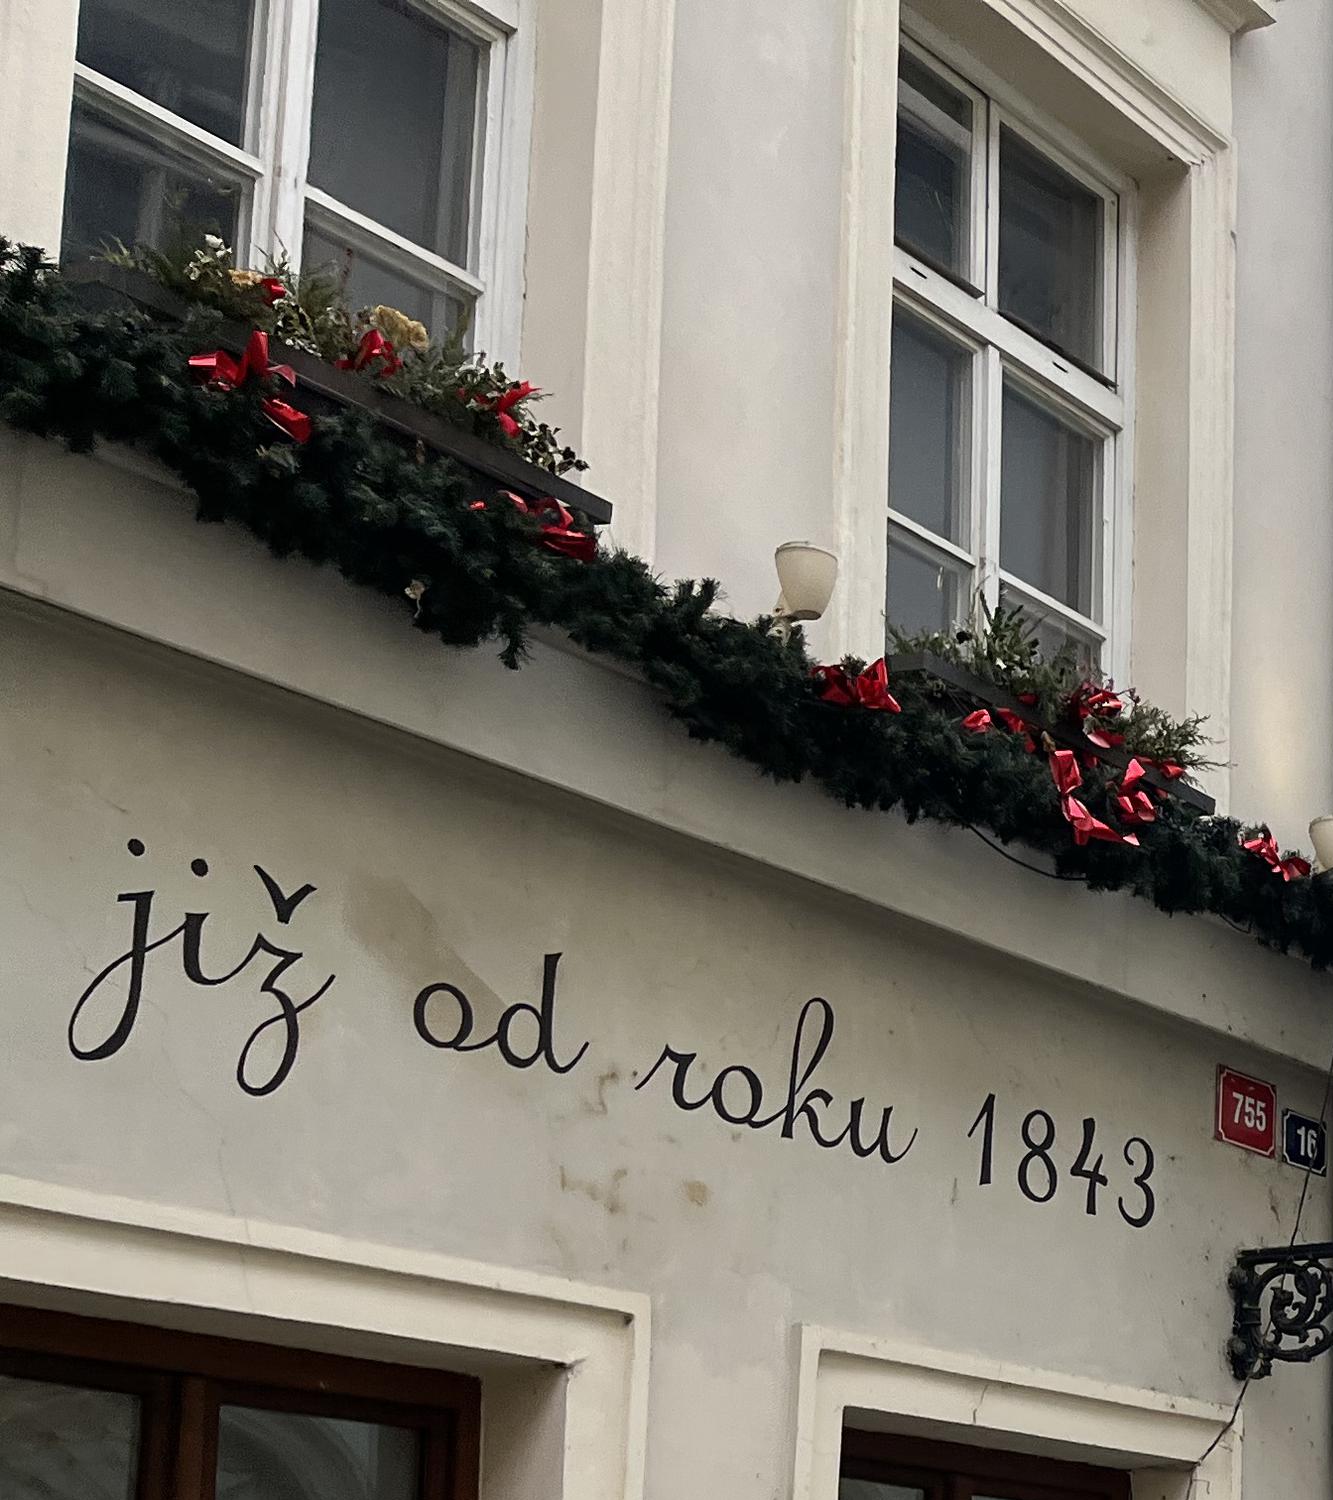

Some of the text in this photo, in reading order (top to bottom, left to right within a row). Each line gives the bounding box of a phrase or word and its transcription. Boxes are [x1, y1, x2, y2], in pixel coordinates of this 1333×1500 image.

[67, 838, 1156, 1228] již od roku 1843
[1232, 1091, 1267, 1132] 755
[1297, 1125, 1318, 1160] 16
